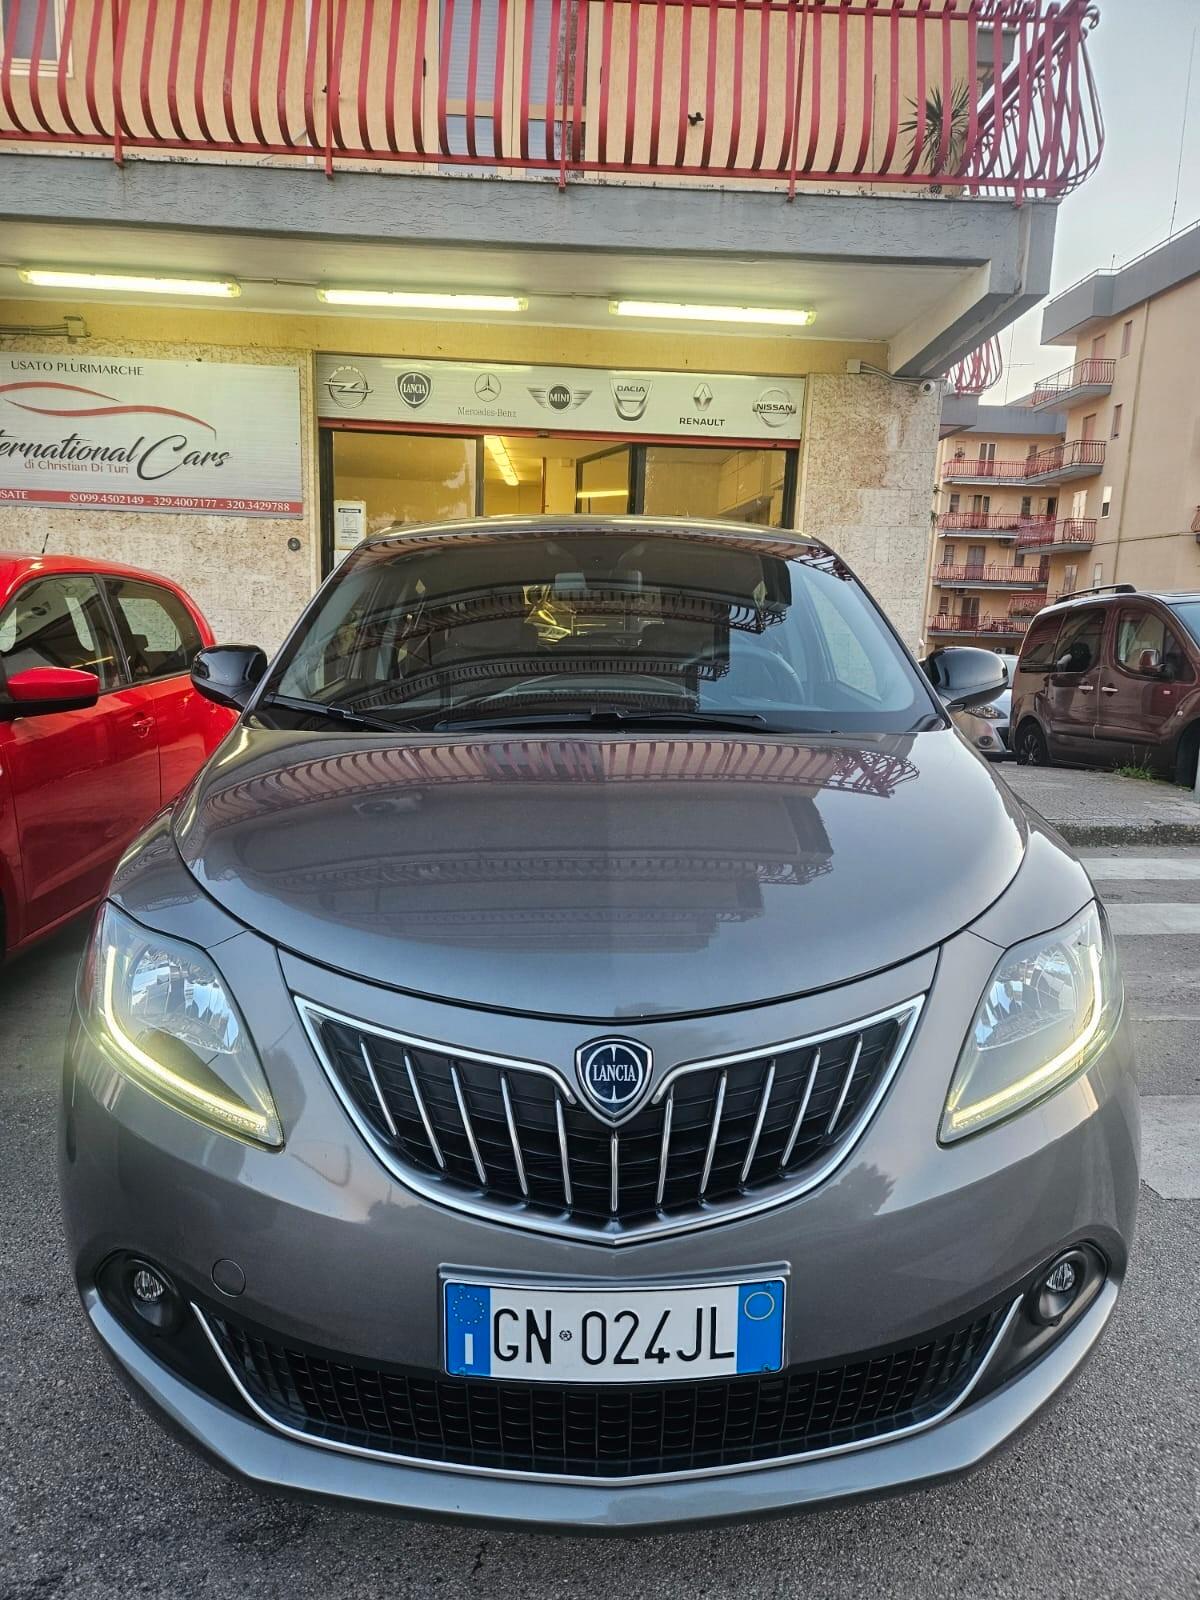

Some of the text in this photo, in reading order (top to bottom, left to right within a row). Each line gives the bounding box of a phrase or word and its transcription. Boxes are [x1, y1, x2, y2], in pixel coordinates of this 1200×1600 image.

[11, 360, 144, 376] USATO PLURIMARCHE
[403, 383, 427, 394] LANCIA
[616, 384, 646, 393] DACIA
[550, 393, 570, 403] MINI
[457, 406, 517, 418] Mercedes-Benz
[756, 403, 793, 412] NISSAN
[679, 417, 725, 427] RENAULT
[137, 434, 232, 480] Cars
[24, 459, 129, 473] di Christian Di Turi
[0, 489, 28, 499] SATE
[79, 493, 144, 504] 099.4502149
[153, 496, 217, 508] 329.4007177
[226, 500, 290, 512] 320.3429788
[592, 1064, 637, 1082] LANCIA
[493, 1307, 735, 1365] GN 024JL
